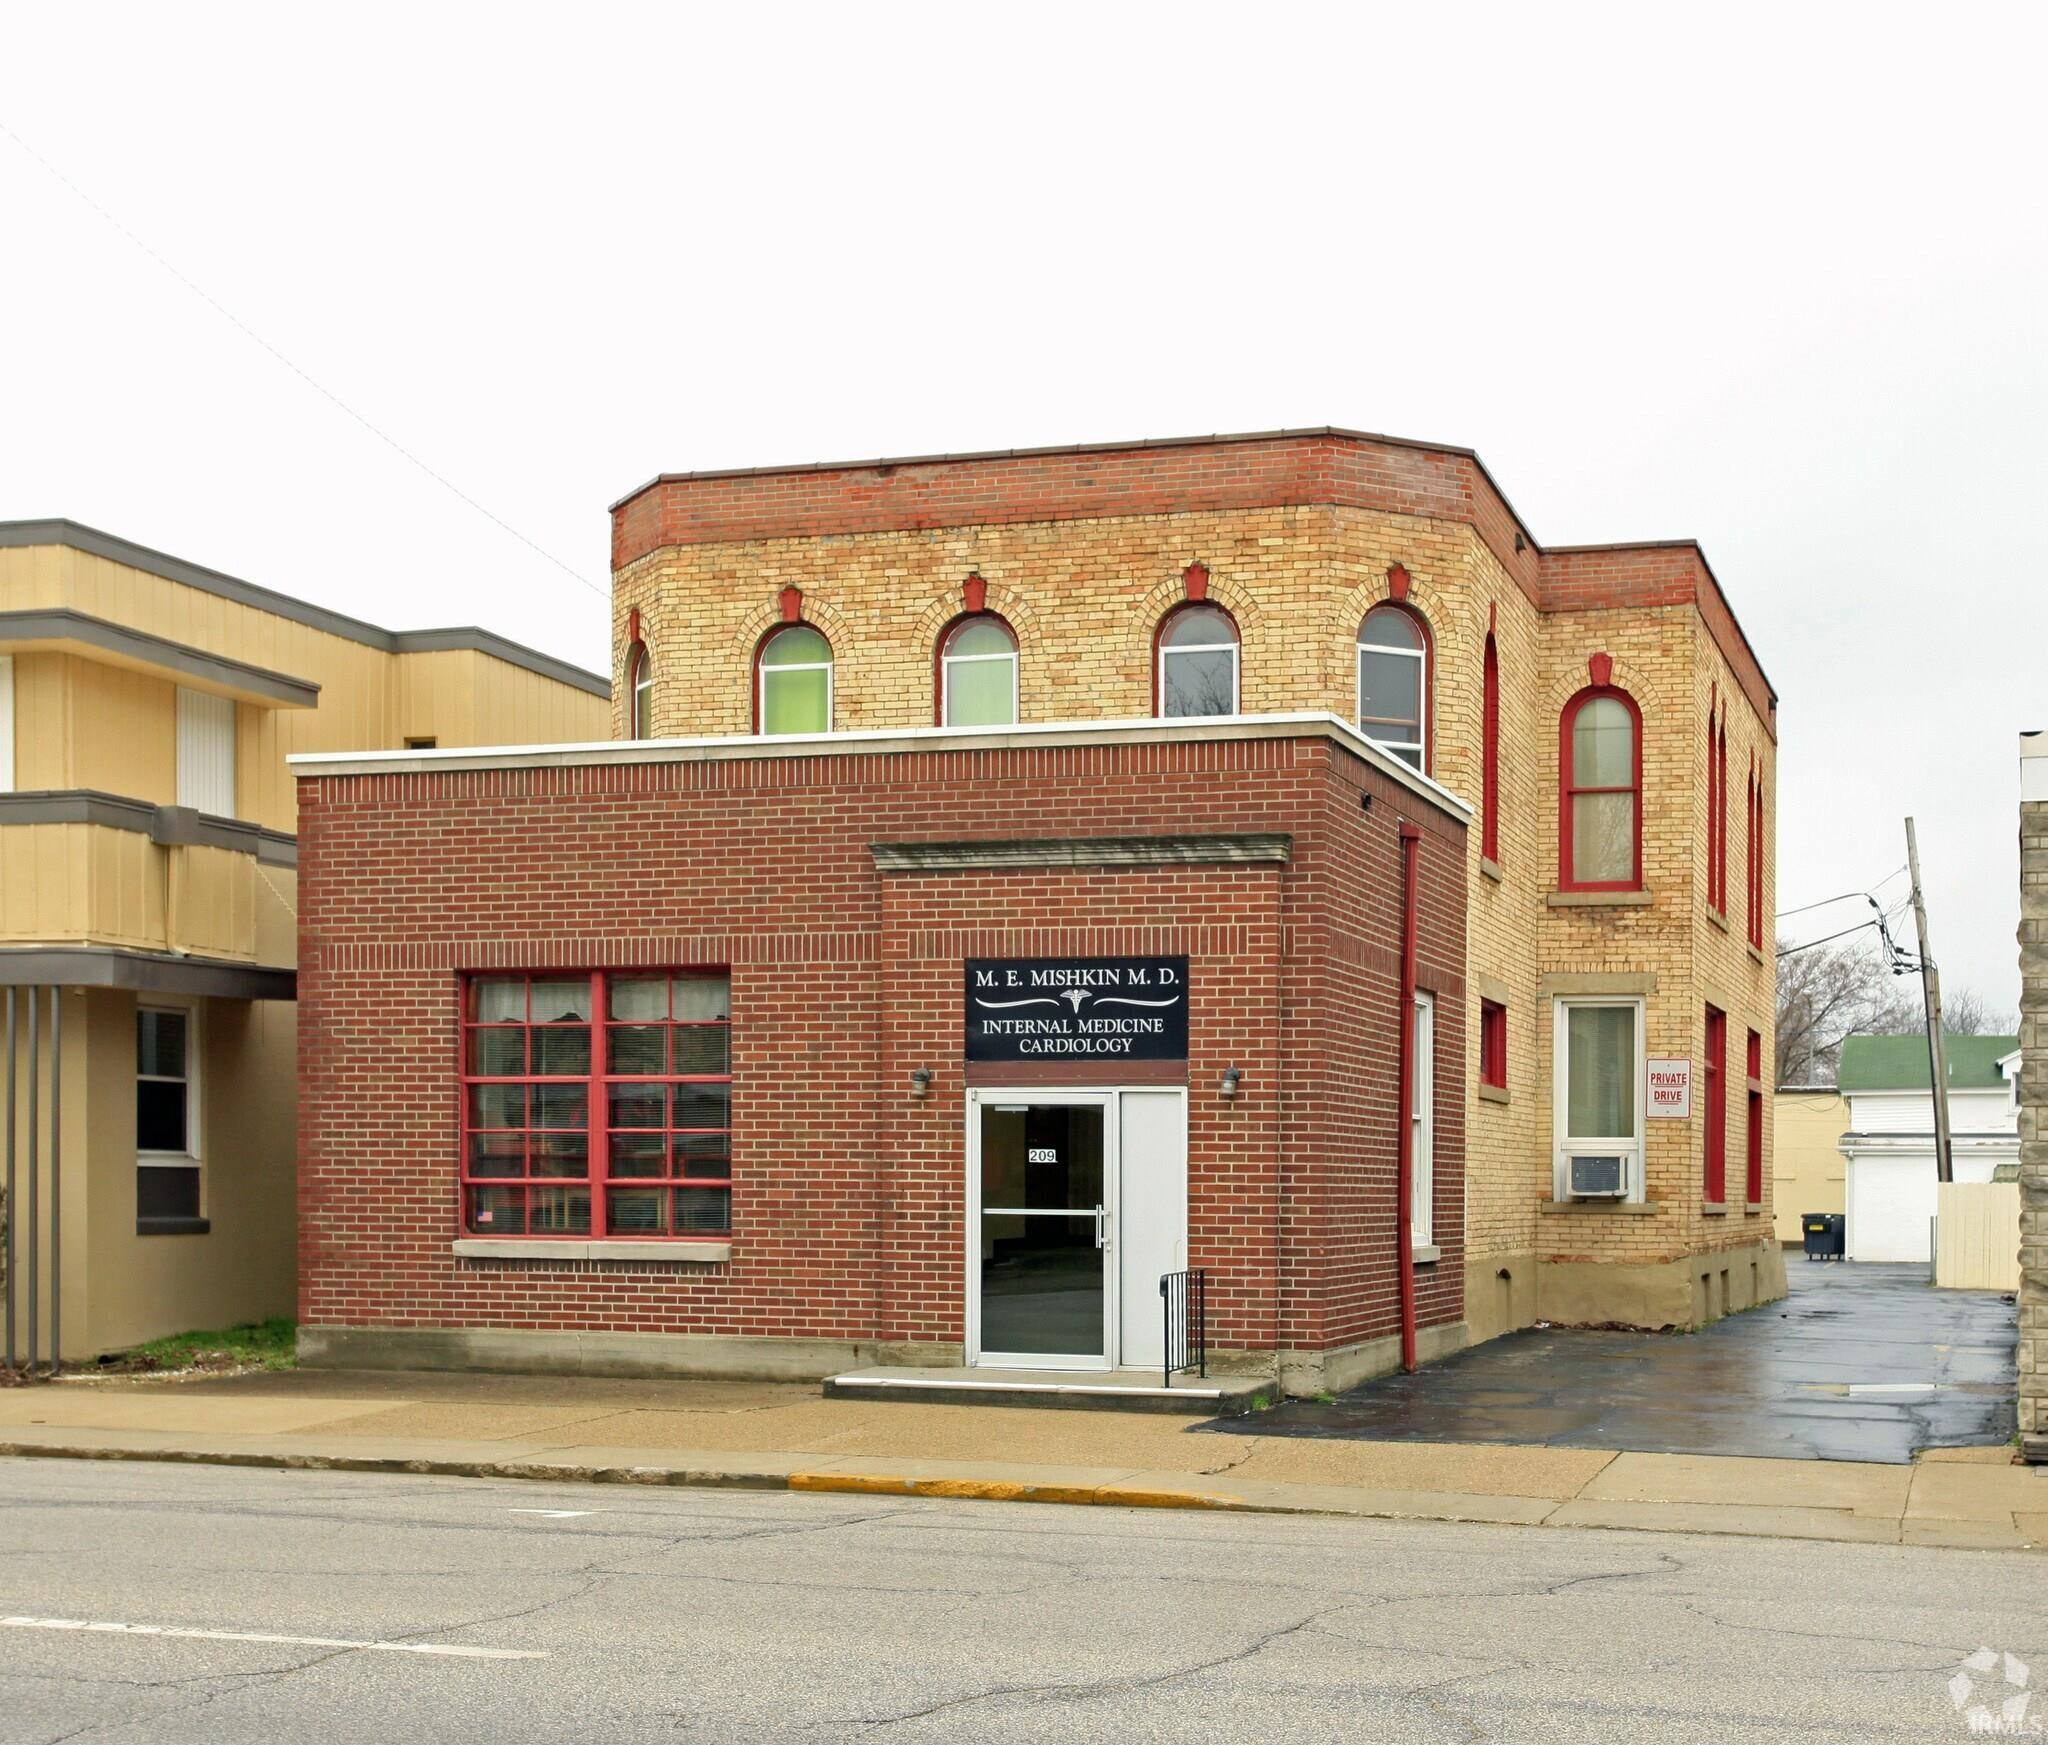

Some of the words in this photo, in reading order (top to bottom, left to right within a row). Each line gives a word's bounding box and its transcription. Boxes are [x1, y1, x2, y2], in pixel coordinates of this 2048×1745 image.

[976, 970, 999, 987] M.
[1006, 970, 1023, 986] E.
[1030, 968, 1120, 986] MISHKIN
[1127, 968, 1151, 985] M.
[1159, 968, 1180, 985] D.
[982, 1019, 1072, 1034] INTERNAL
[1078, 1018, 1164, 1033] MEDICINE
[1019, 1038, 1133, 1053] CARDIOLOGY
[1650, 1072, 1687, 1084] PRIVATE
[1654, 1090, 1682, 1101] DRIVE
[1030, 1150, 1055, 1161] 209
